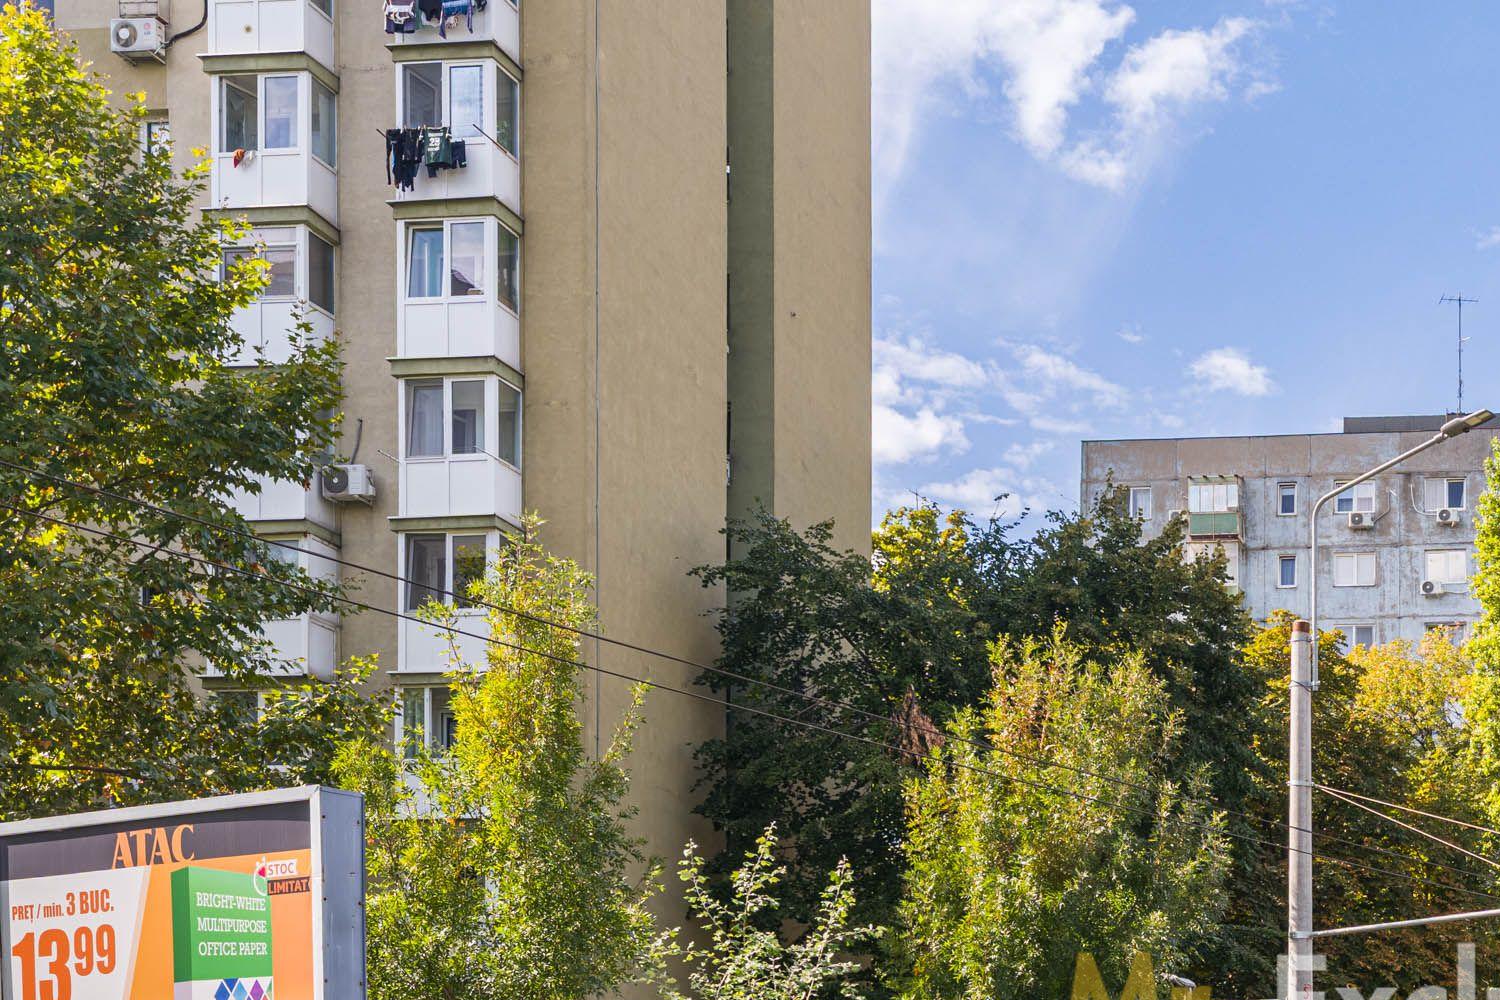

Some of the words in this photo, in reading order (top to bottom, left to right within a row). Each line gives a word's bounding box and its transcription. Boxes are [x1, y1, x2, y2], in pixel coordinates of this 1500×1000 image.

[112, 824, 195, 870] ATAC
[267, 862, 295, 876] STOC
[268, 879, 308, 894] LIMITAT
[43, 902, 64, 918] min.
[66, 892, 76, 916] 3
[79, 888, 114, 914] BUC.
[196, 892, 266, 911] BRIGHT-WHITE
[197, 917, 267, 933] MULTIPURPOSE
[198, 941, 237, 956] OFFICE
[238, 942, 268, 955] PAPER
